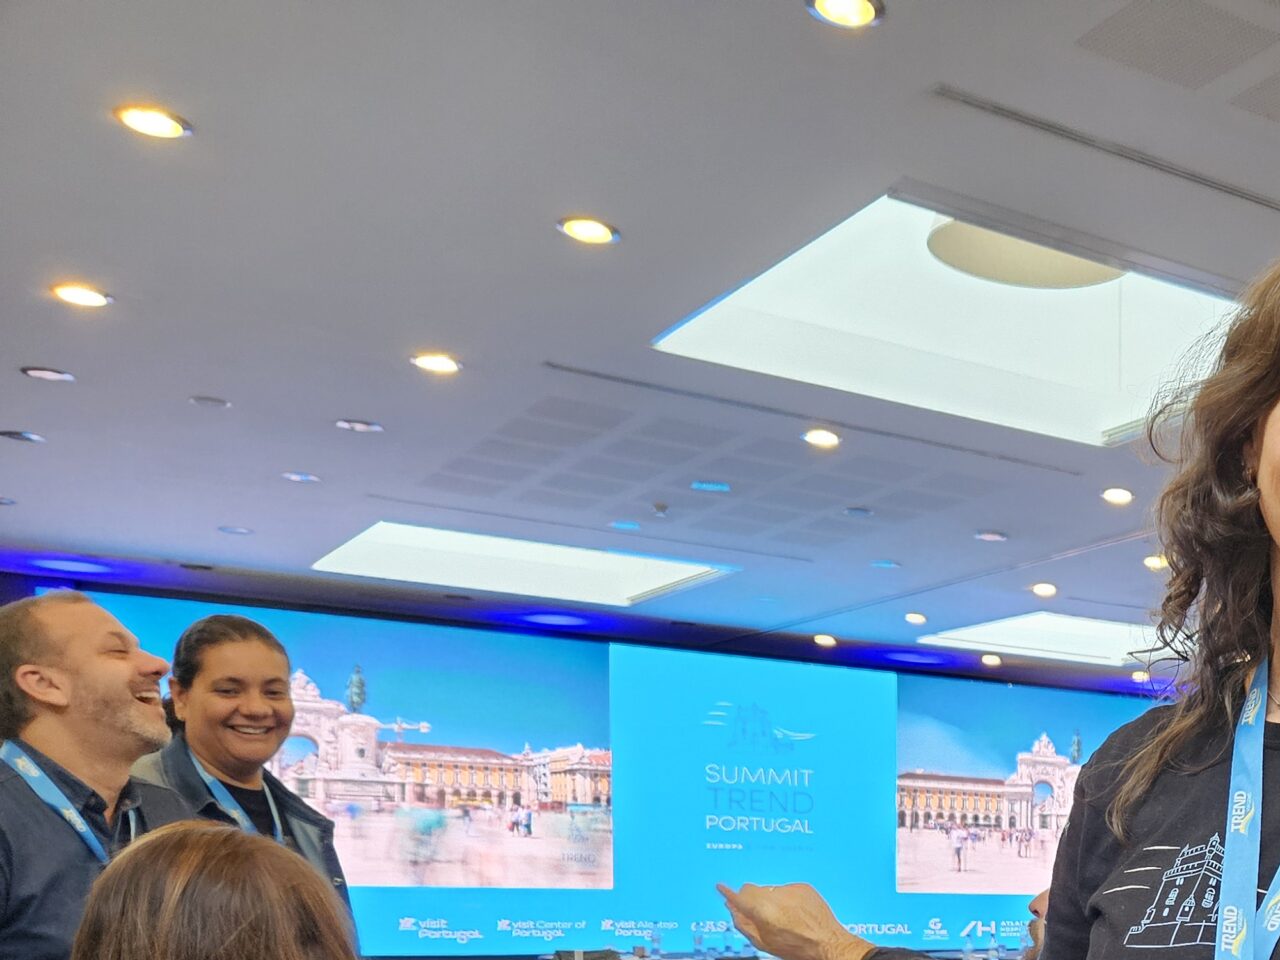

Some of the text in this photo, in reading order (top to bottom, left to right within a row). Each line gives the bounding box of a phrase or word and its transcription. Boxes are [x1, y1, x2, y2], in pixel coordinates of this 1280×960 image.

[705, 764, 815, 787] SUMMIT
[706, 787, 815, 814] TREND
[1230, 790, 1247, 833] TREND
[705, 815, 815, 834] PORTUGAL
[536, 920, 573, 929] Center
[615, 929, 653, 940] Portug
[847, 923, 912, 935] ORTUGAL
[1221, 905, 1238, 951] TREND
